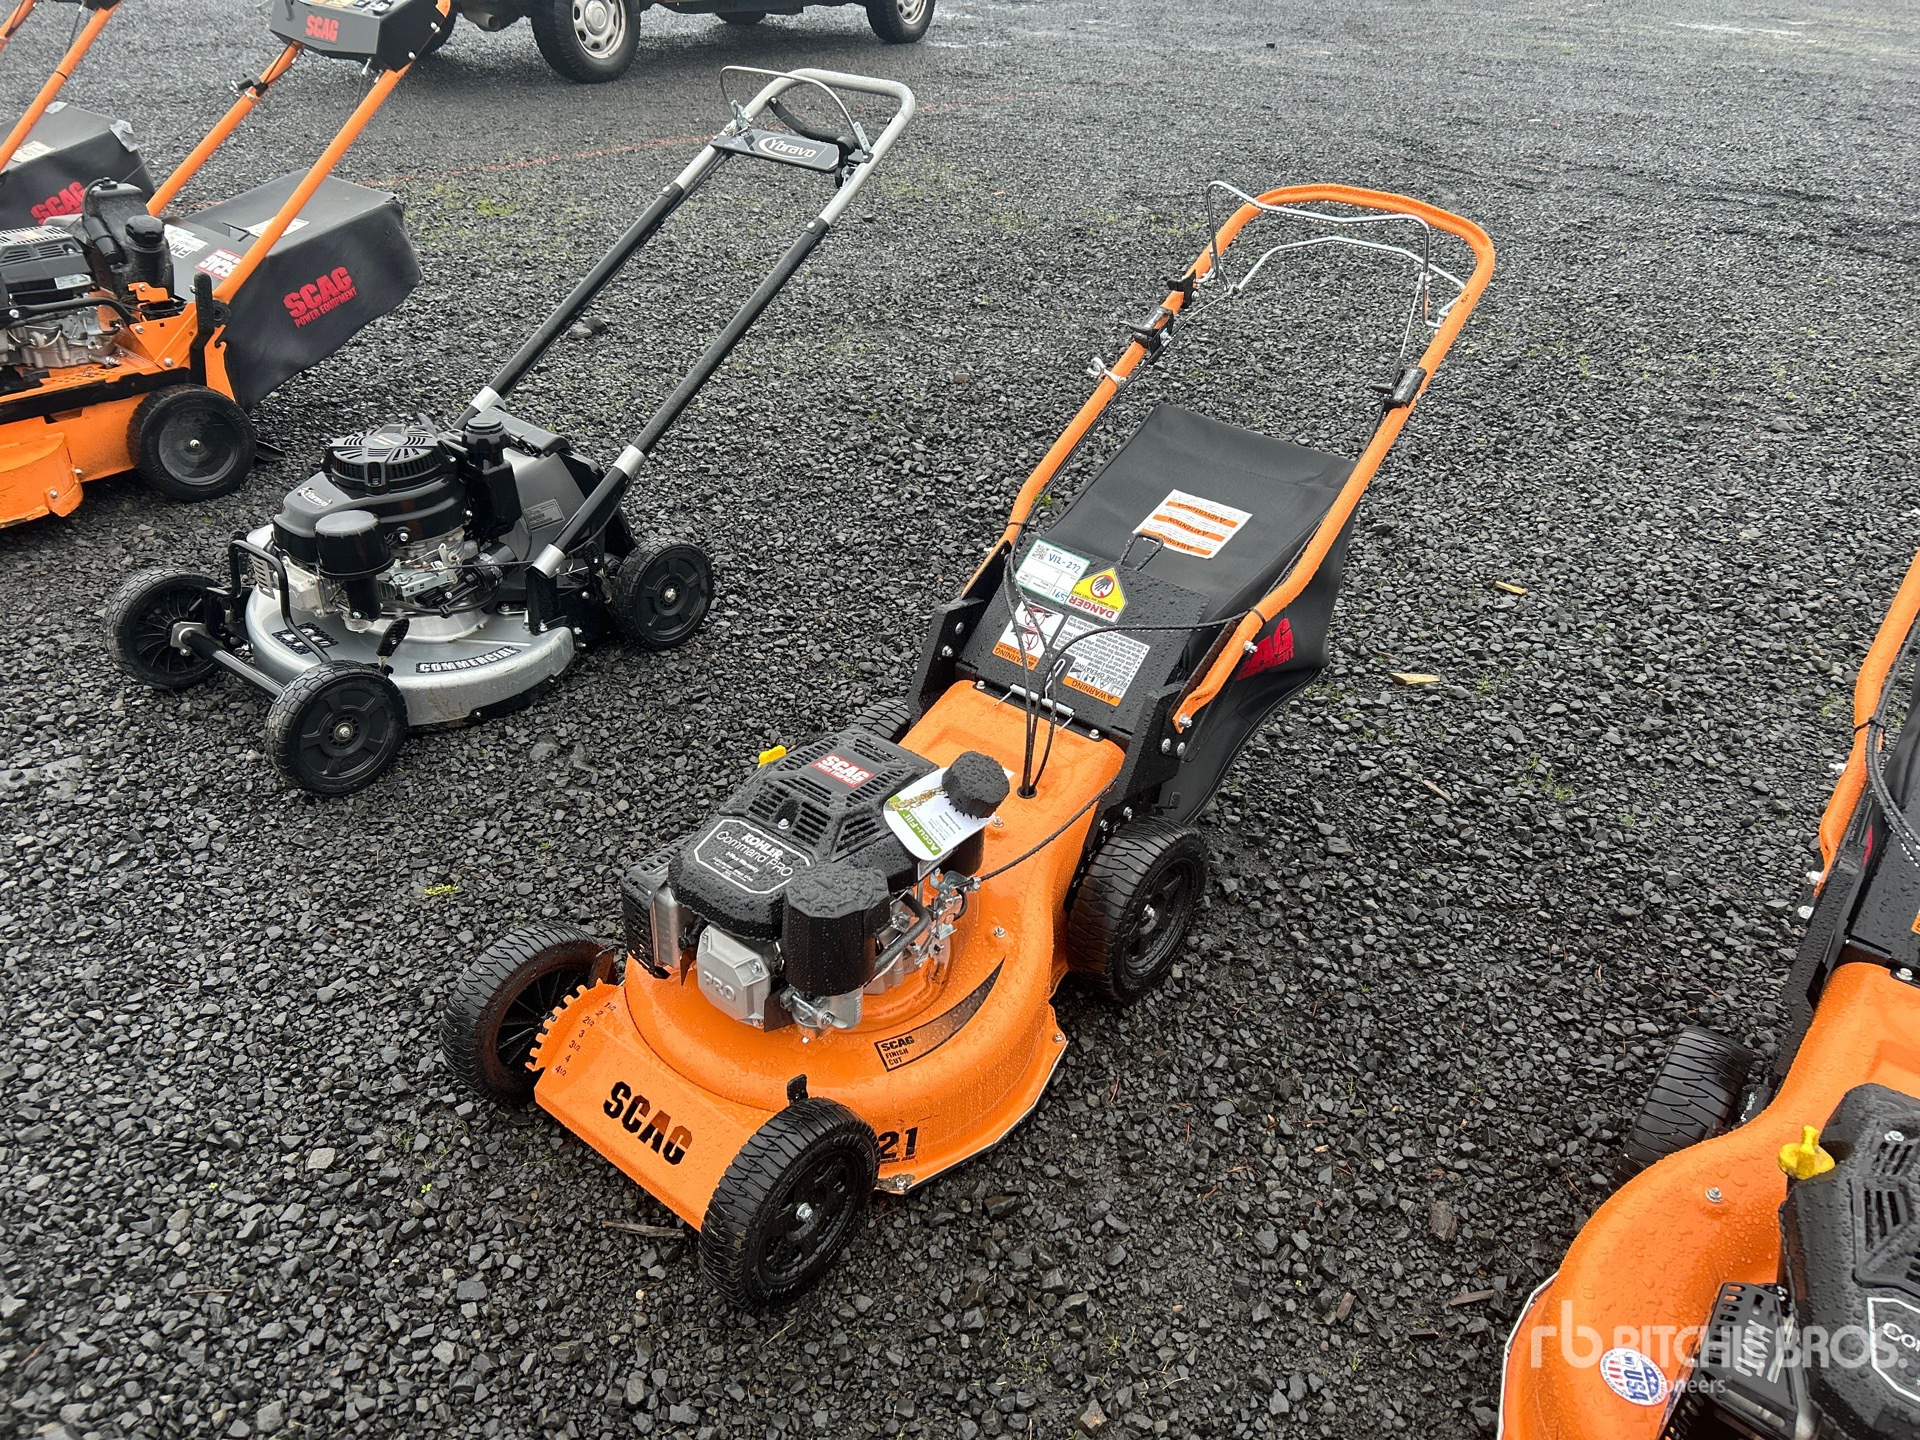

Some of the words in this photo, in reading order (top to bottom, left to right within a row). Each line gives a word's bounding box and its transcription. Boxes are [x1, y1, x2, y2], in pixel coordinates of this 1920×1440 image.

[305, 15, 339, 41] SCAG
[31, 181, 85, 219] SCAG
[283, 266, 352, 318] SCAG
[294, 308, 320, 328] POWER
[319, 286, 357, 315] EQUIPMENT
[1167, 517, 1201, 534] ATTENTION
[1068, 594, 1114, 619] DANGER
[420, 647, 517, 672] COMMERCIAL
[994, 647, 1023, 663] ARNING
[1074, 661, 1105, 678] OPERATING
[1105, 674, 1128, 687] BEFORE
[1070, 679, 1107, 698] WARNING
[821, 755, 870, 782] SCAG
[903, 812, 939, 853] Accu-Fill
[716, 831, 769, 863] Command
[766, 858, 793, 877] PRO
[703, 970, 736, 1002] PRO
[578, 1029, 586, 1038] 3
[880, 1035, 915, 1052] SCAG
[565, 1054, 572, 1063] 4
[885, 1047, 909, 1059] FINISH
[888, 1056, 903, 1066] CUT
[602, 1081, 693, 1166] SCAG
[878, 1126, 918, 1160] 21
[1623, 1369, 1650, 1401] USA
